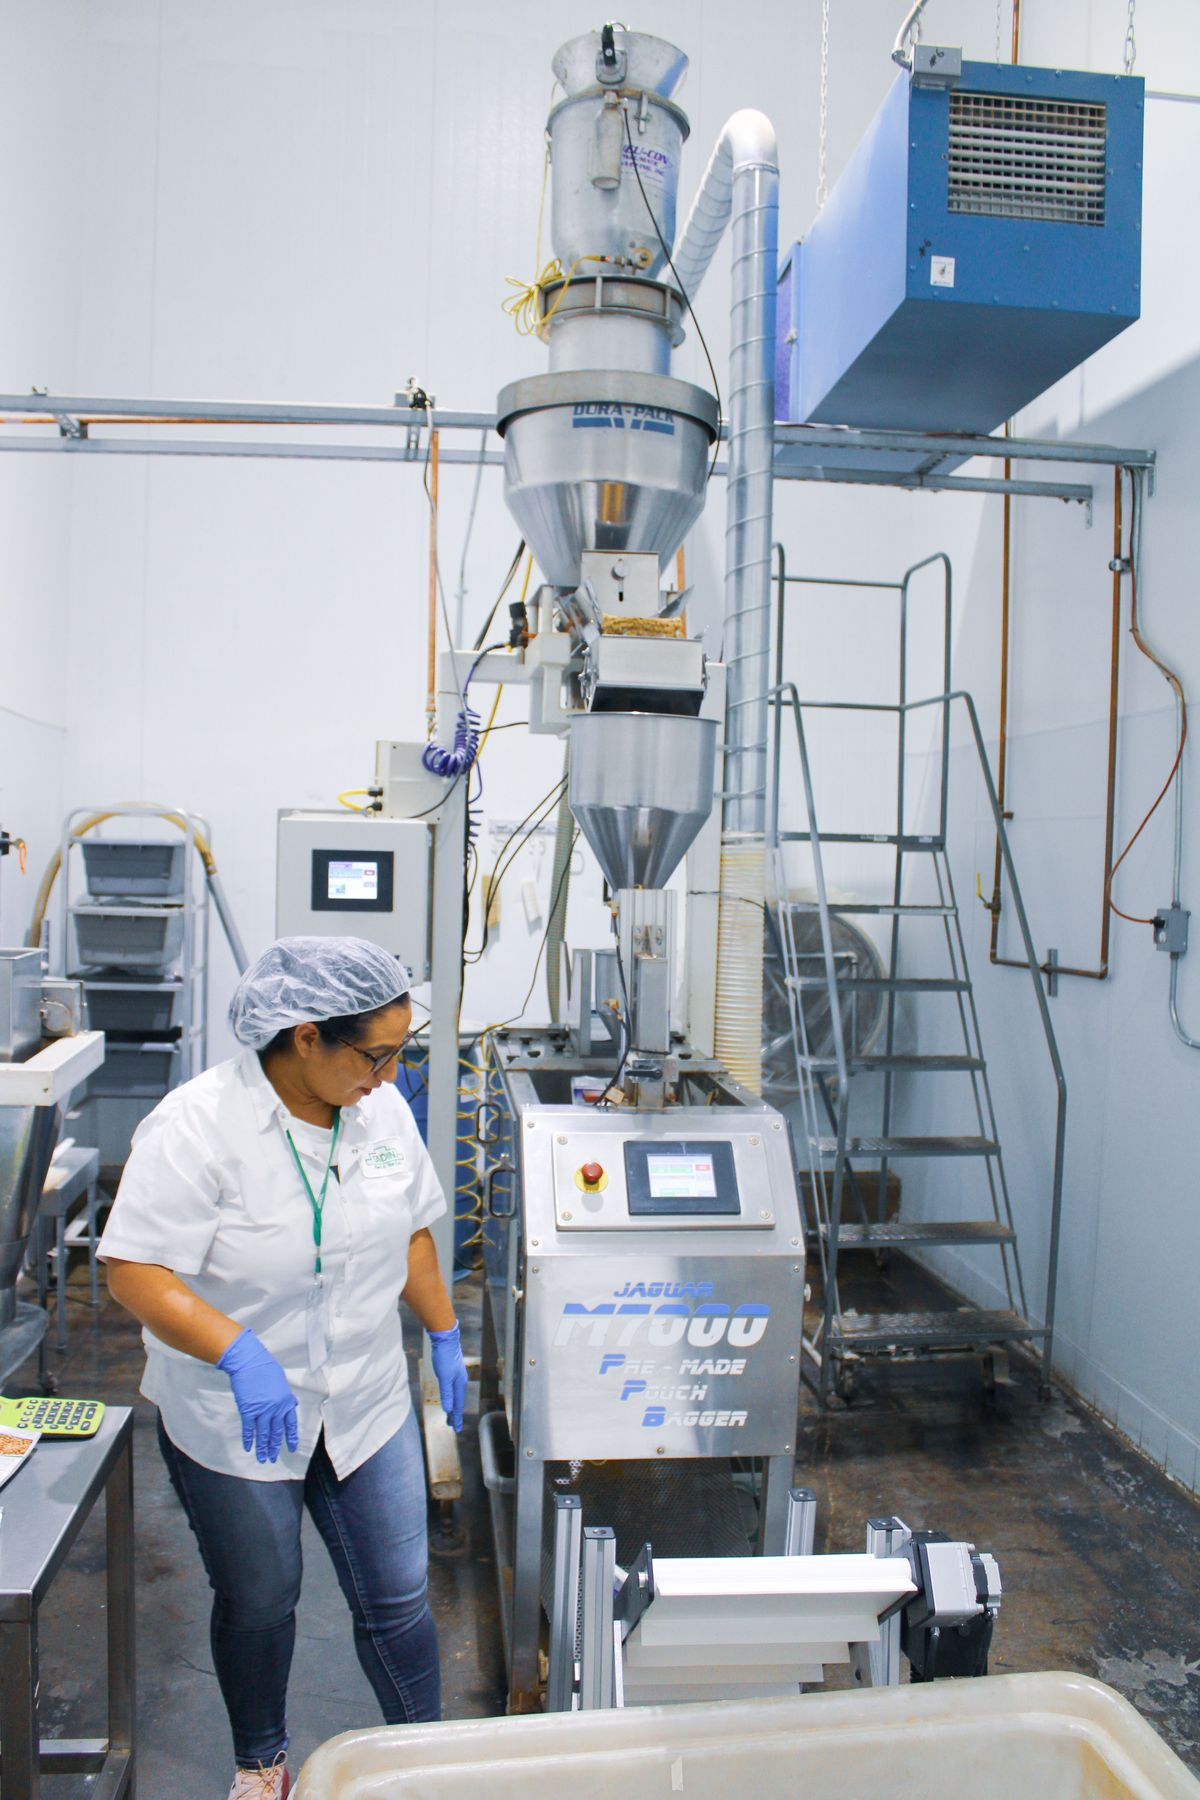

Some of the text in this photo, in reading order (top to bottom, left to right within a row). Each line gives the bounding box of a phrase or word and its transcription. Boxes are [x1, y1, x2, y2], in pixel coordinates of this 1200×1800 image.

[613, 1281, 714, 1298] JAGUAR
[553, 1303, 772, 1347] M7000
[620, 1380, 708, 1401] POUCH
[641, 1406, 748, 1428] BAGGER
